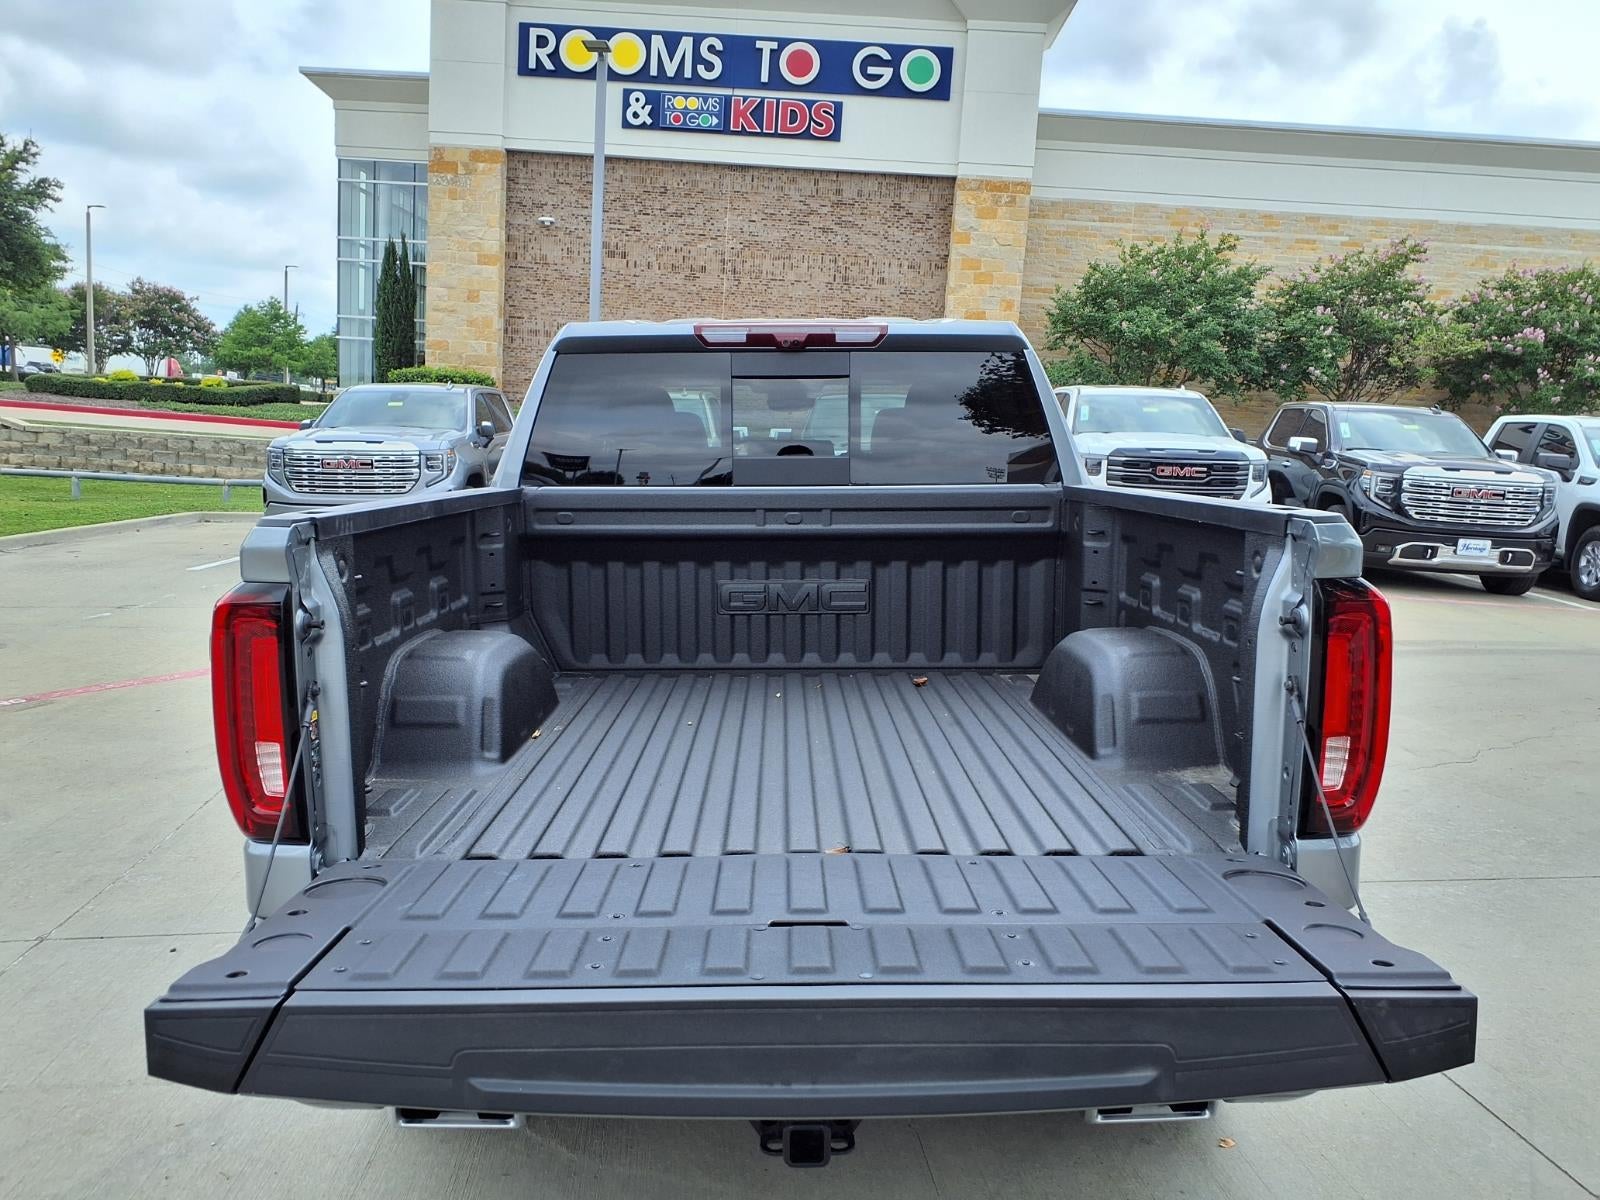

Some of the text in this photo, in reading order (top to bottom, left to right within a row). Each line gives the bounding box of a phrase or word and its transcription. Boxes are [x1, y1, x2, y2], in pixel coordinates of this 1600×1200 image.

[528, 27, 941, 92] ROOMS TO GO
[664, 95, 720, 112] ROOMS
[626, 91, 835, 137] & KIDS
[665, 112, 713, 127] TO GO
[322, 459, 373, 469] GMC
[1156, 466, 1208, 477] GMC
[1453, 487, 1504, 500] GMC
[720, 583, 867, 612] GMC
